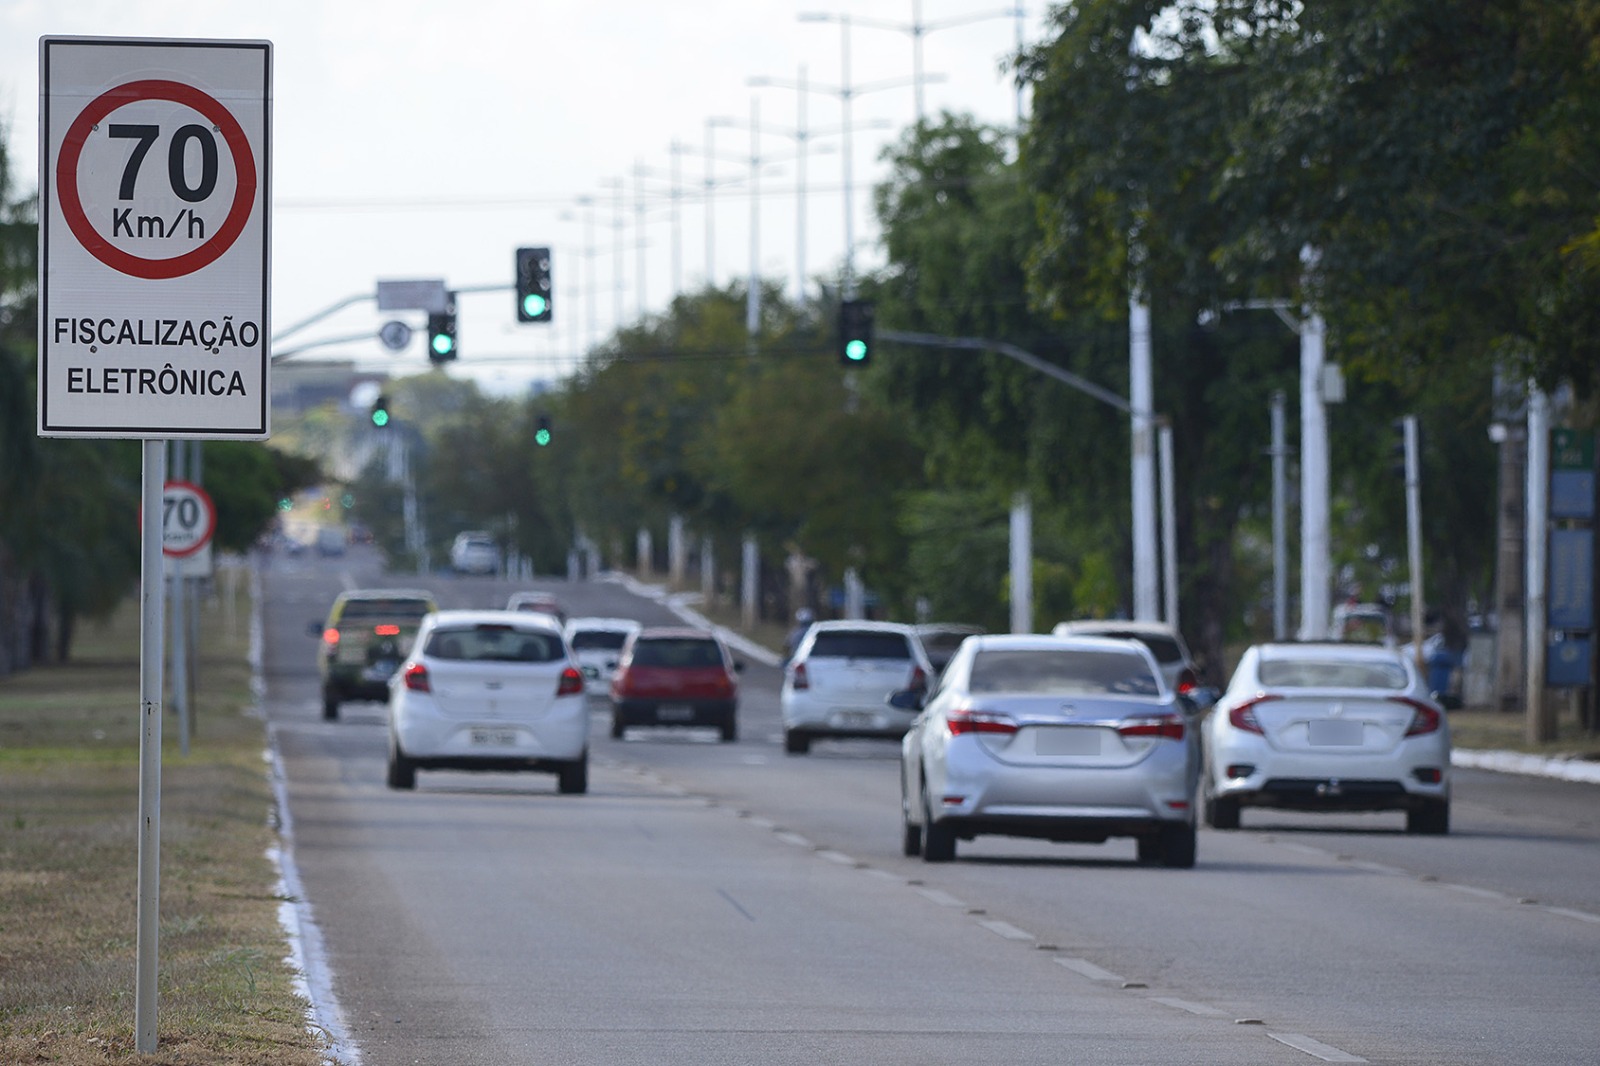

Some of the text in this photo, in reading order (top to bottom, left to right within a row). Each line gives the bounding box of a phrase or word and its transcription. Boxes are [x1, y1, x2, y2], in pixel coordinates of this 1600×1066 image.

[108, 123, 219, 203] 70
[113, 207, 206, 239] Km/h
[54, 315, 260, 351] FISCALIZAÇÃO
[67, 362, 247, 397] ELETRÔNICA
[163, 496, 200, 530] 70
